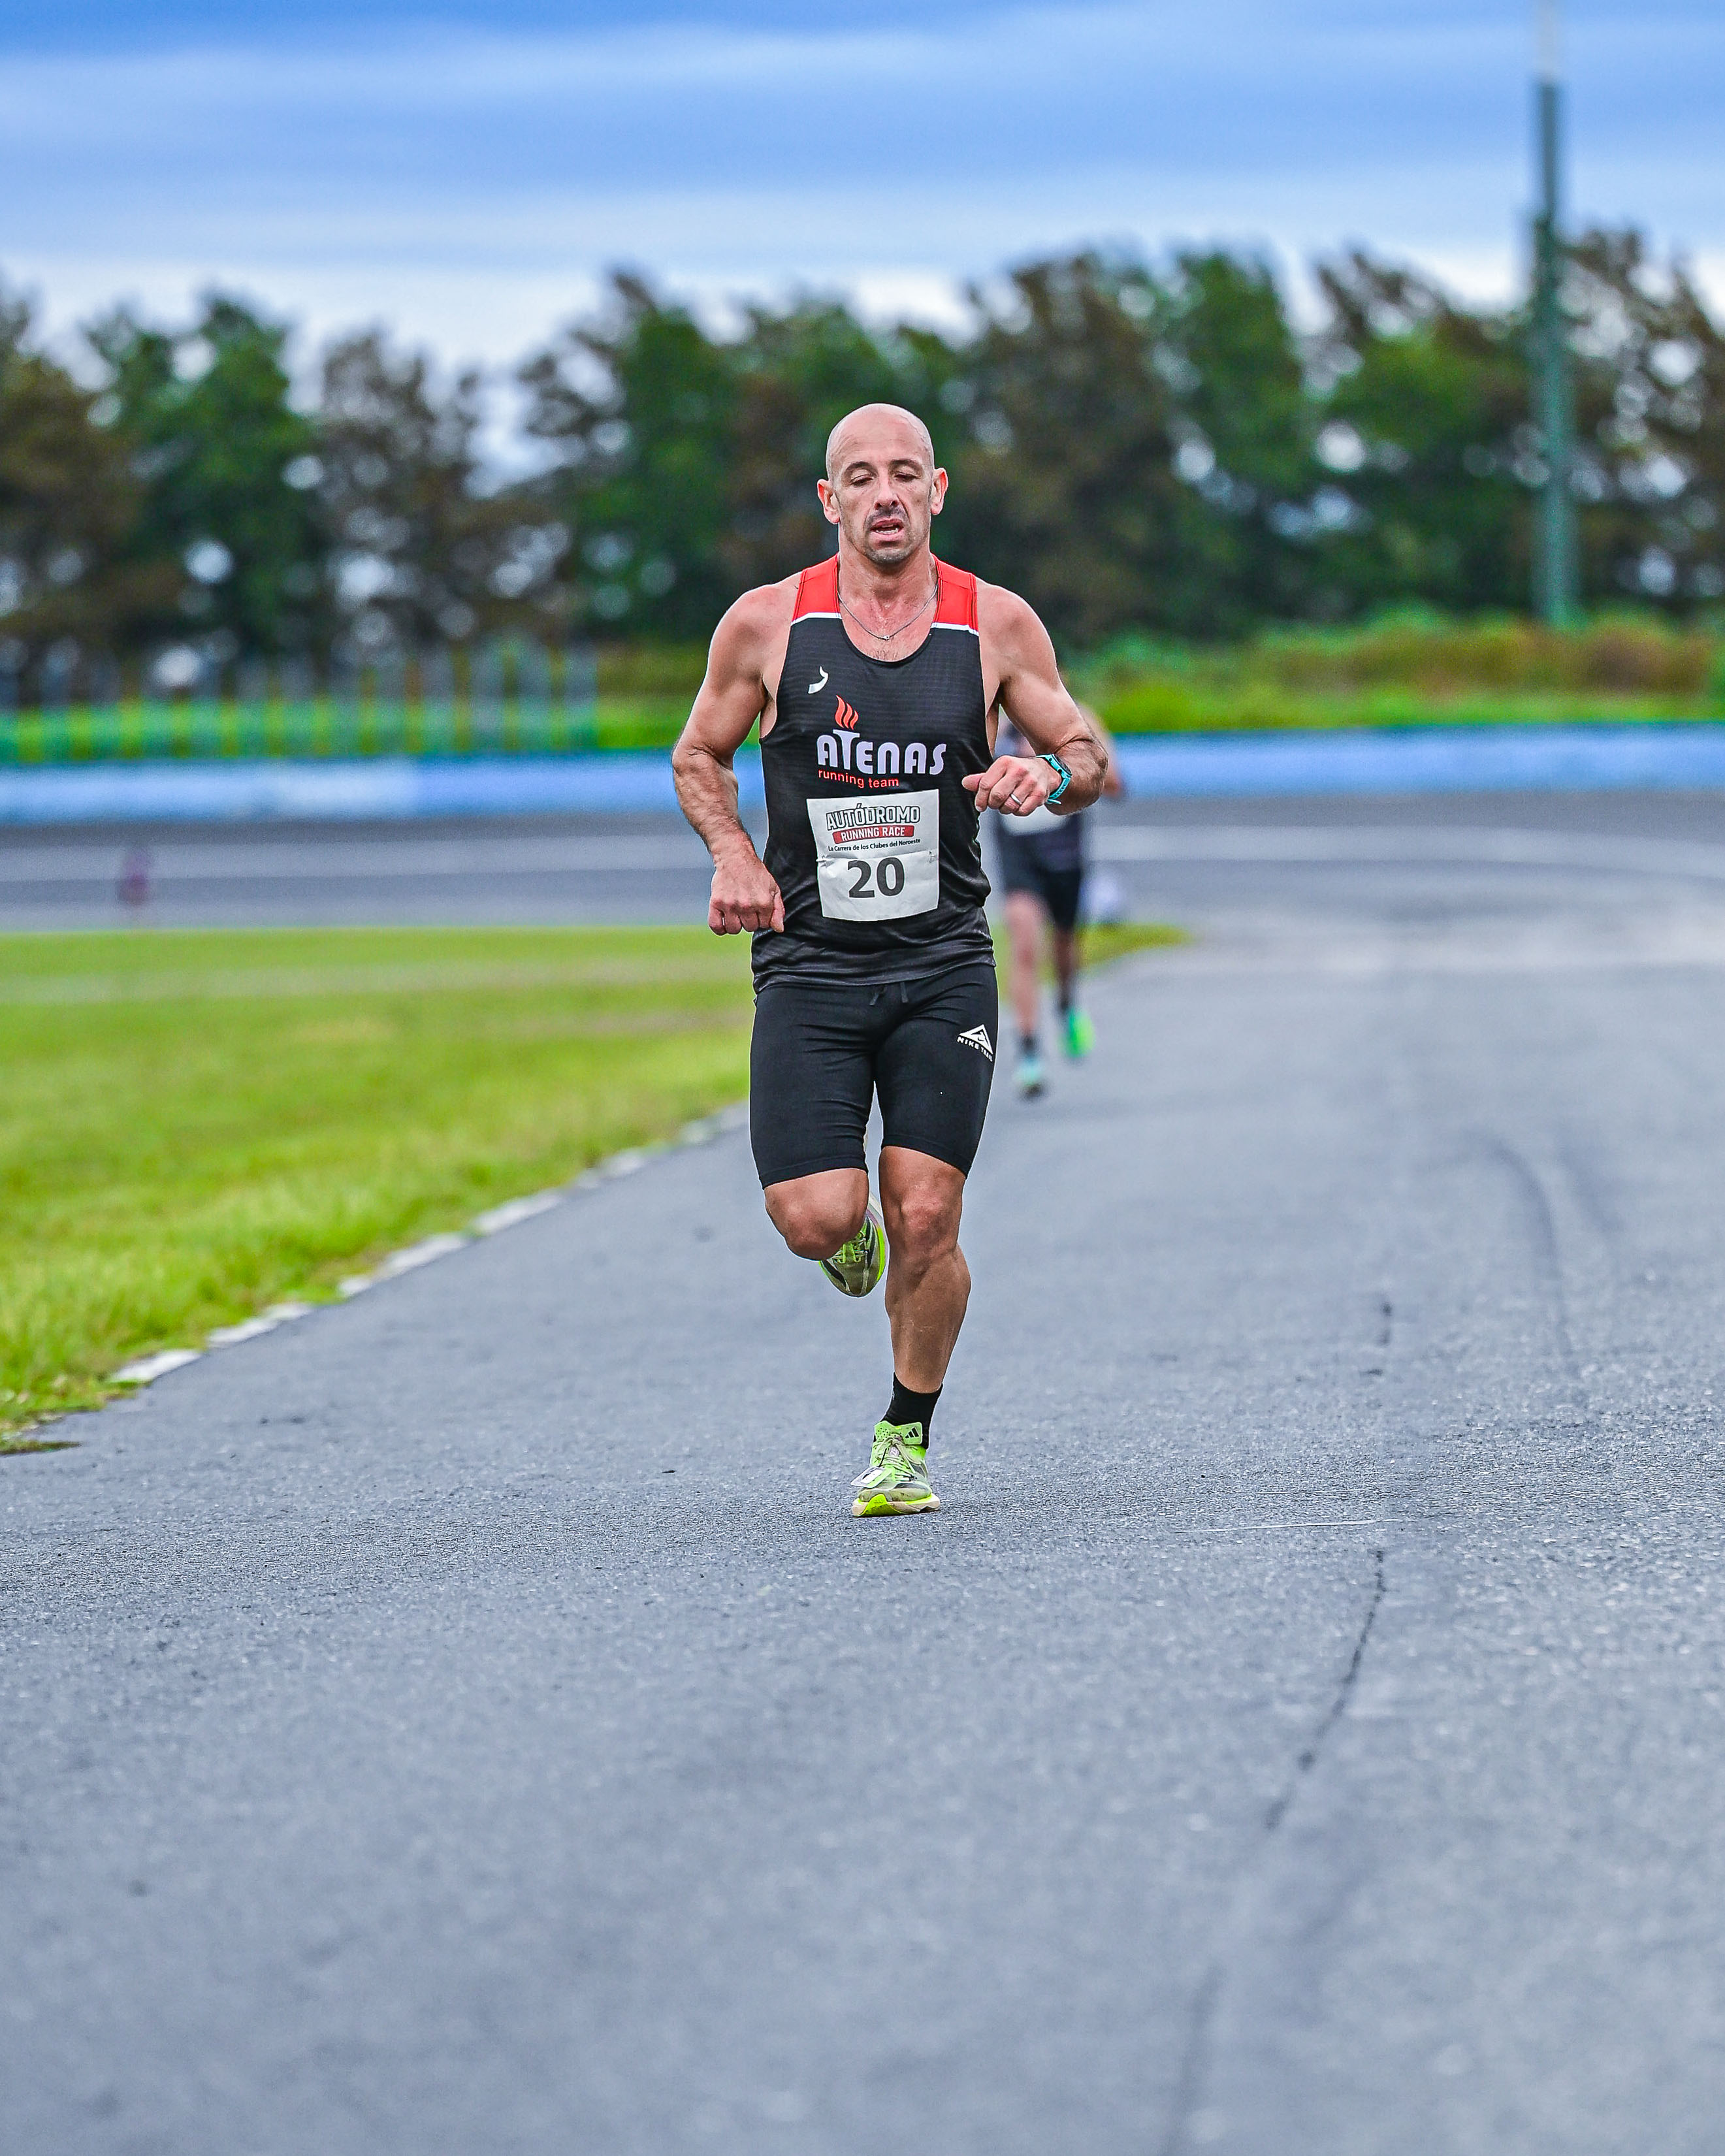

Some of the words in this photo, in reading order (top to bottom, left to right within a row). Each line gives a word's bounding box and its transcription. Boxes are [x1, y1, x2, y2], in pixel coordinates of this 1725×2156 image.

[816, 729, 946, 775] ATENAS
[818, 769, 864, 788] running
[869, 778, 899, 788] team
[826, 803, 920, 831] AUTÓDROMO
[841, 827, 880, 841] RUNNING
[882, 826, 905, 837] RACE
[848, 857, 905, 898] 20
[956, 1036, 980, 1050] NIKE
